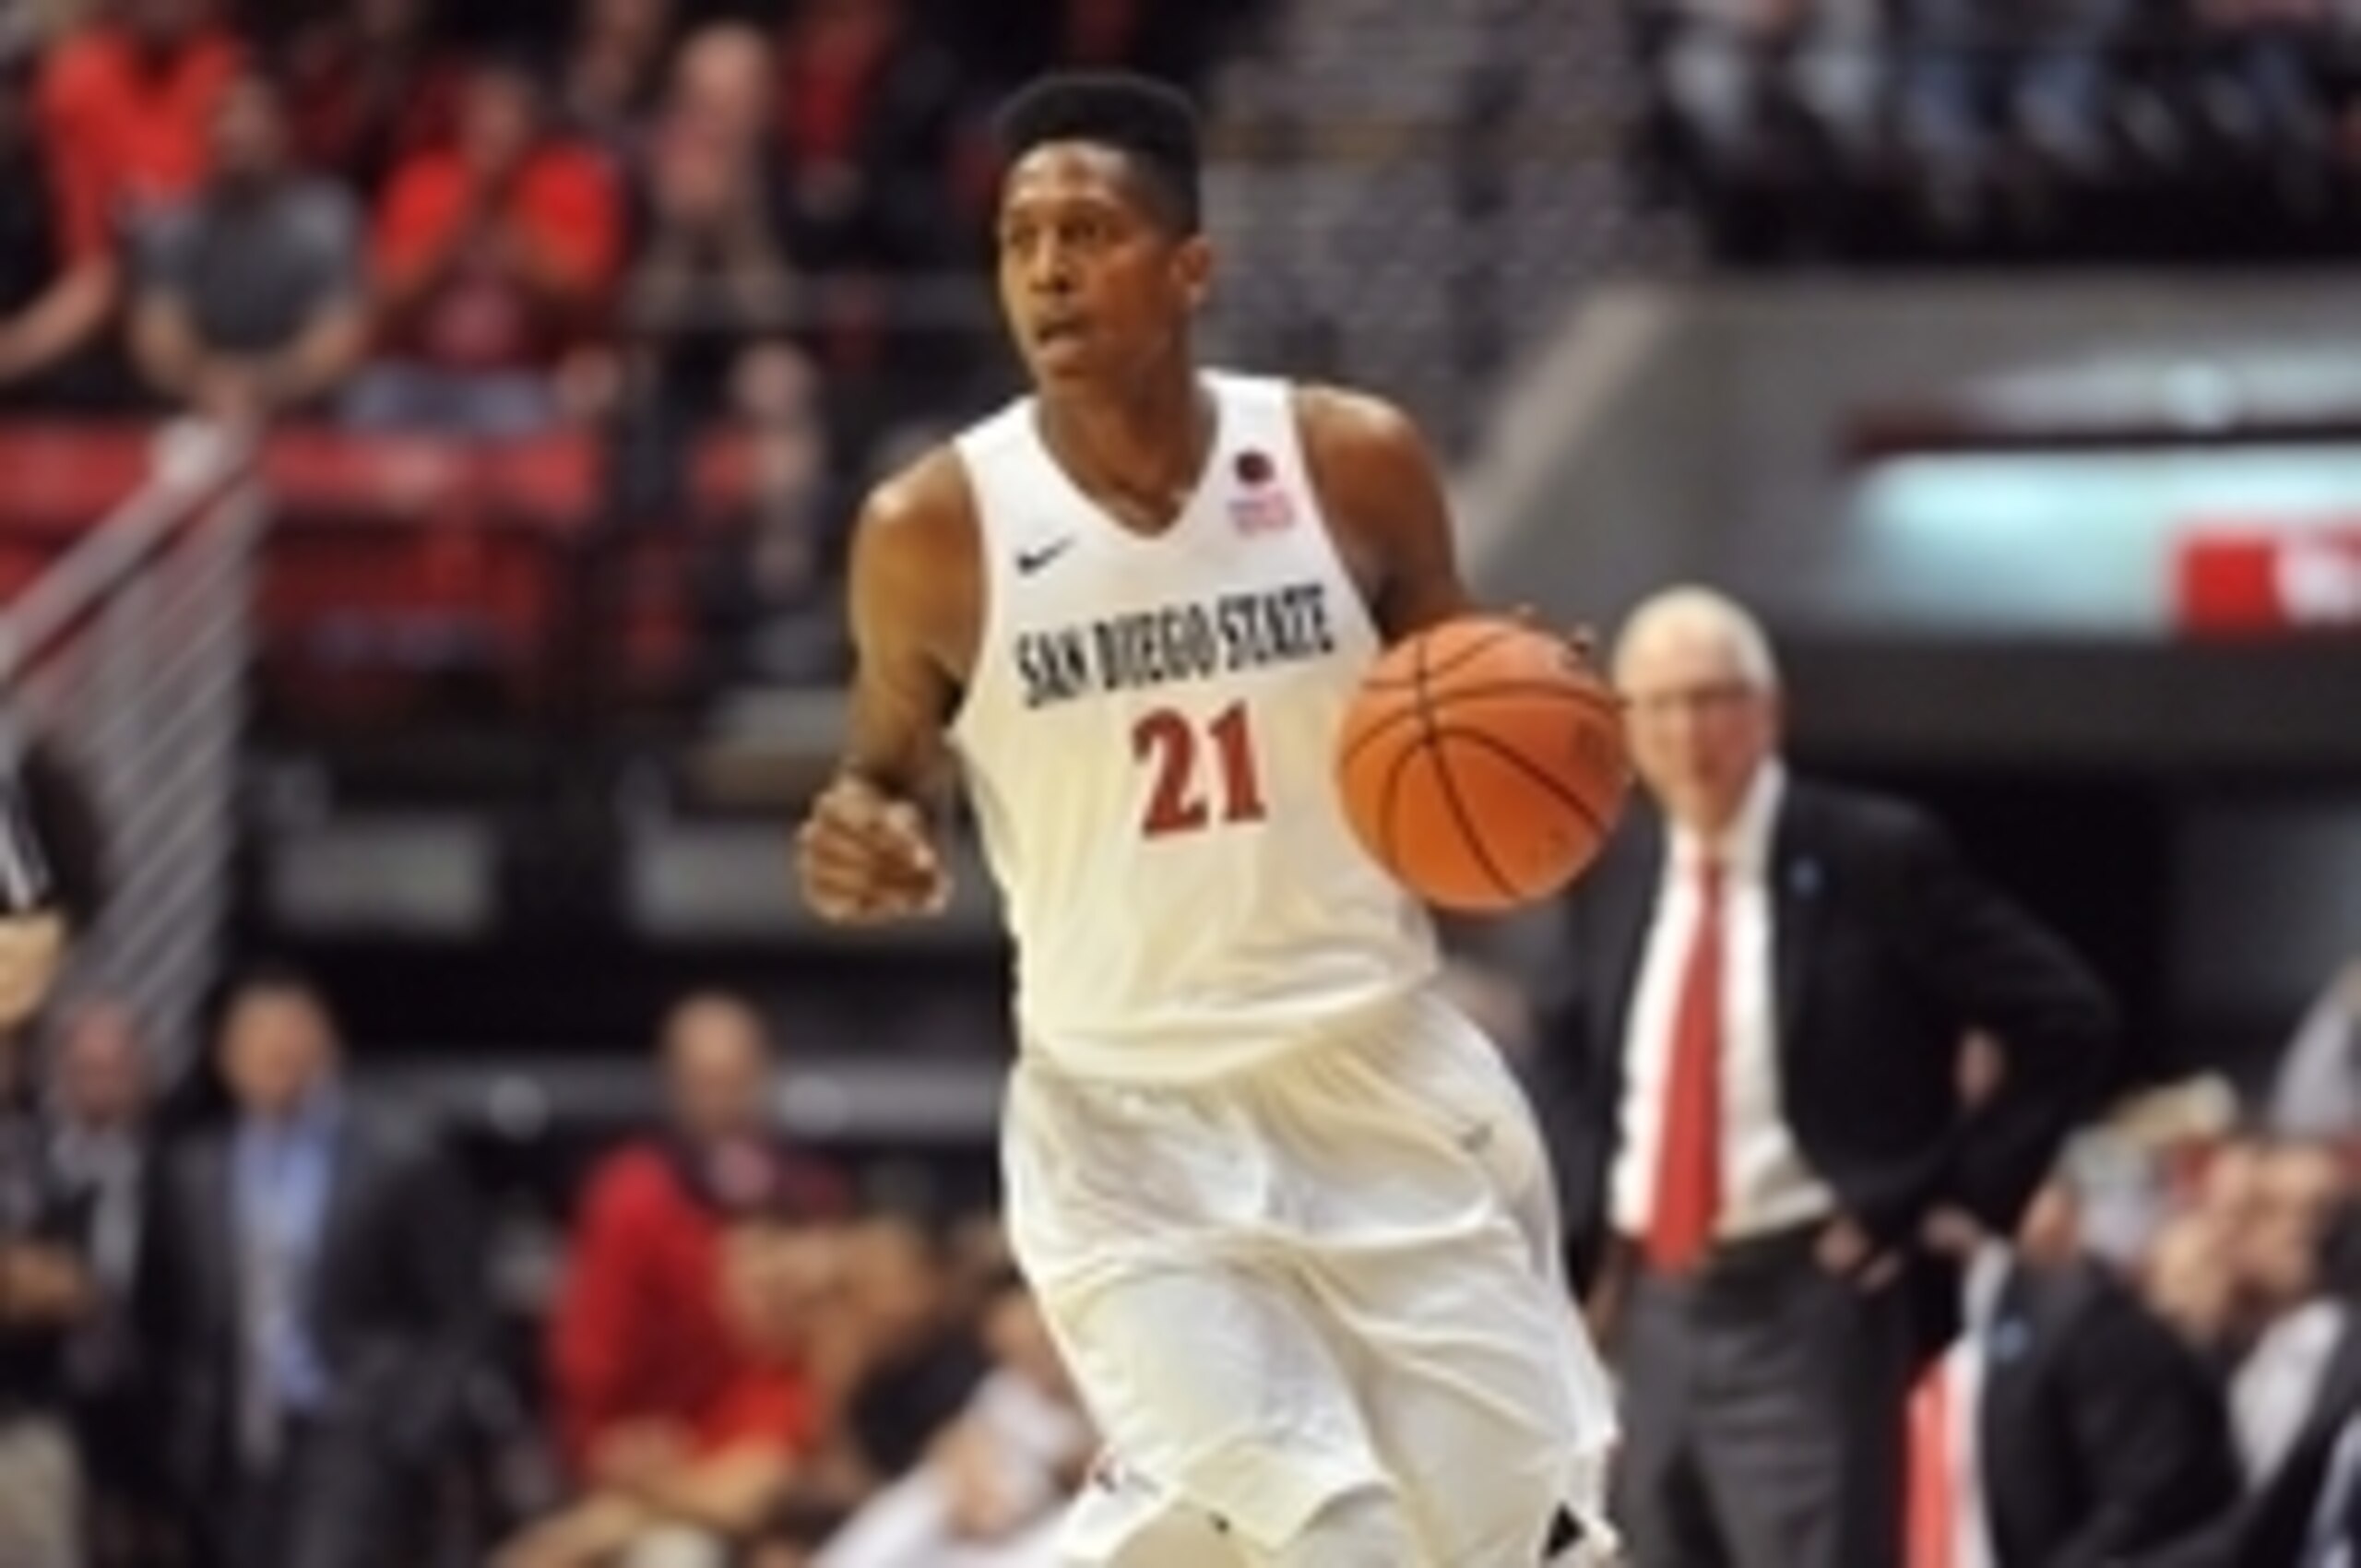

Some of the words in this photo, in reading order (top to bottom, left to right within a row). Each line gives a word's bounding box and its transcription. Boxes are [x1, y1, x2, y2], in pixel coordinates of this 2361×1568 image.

[1016, 623, 1089, 709] SAN
[1093, 602, 1217, 691] DIEGO
[1217, 582, 1336, 672] STATE
[1132, 698, 1267, 839] 21
